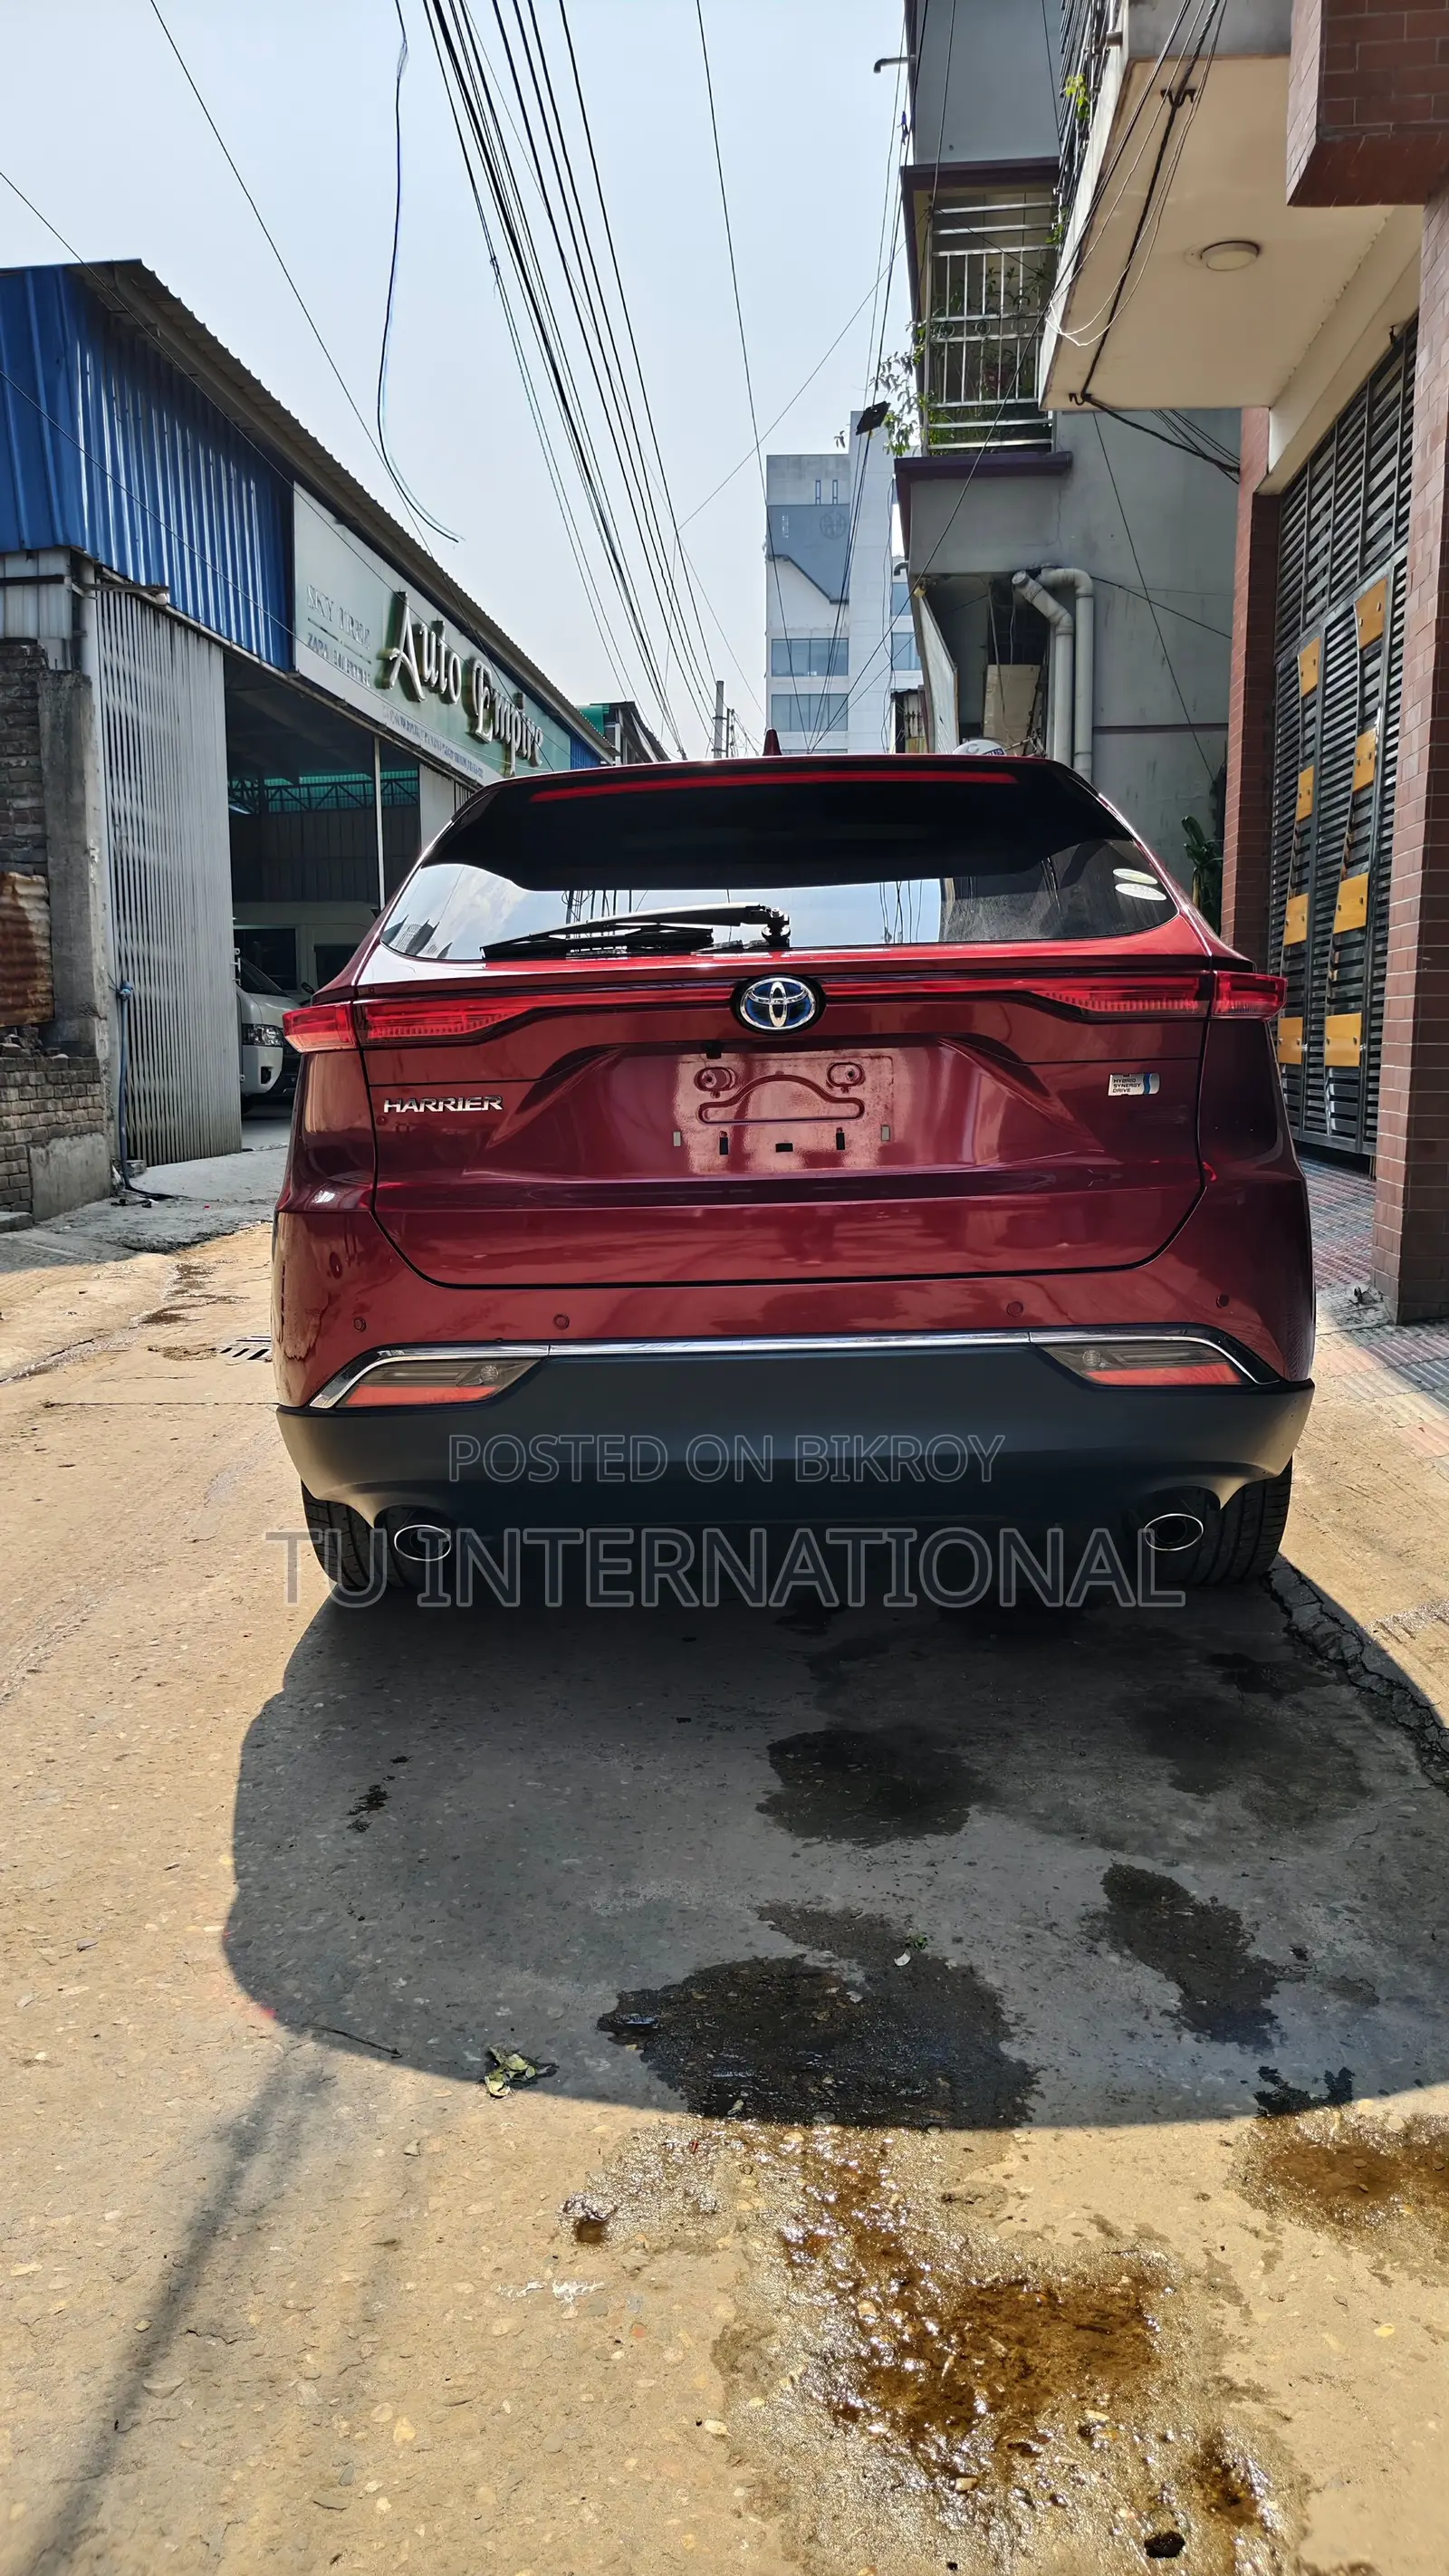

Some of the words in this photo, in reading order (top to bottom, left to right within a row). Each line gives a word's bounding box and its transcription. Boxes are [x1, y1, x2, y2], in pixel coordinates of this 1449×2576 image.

[307, 584, 333, 623] SKY
[388, 590, 462, 705] Auto
[472, 658, 543, 777] Empire
[383, 1096, 504, 1113] HARRIER
